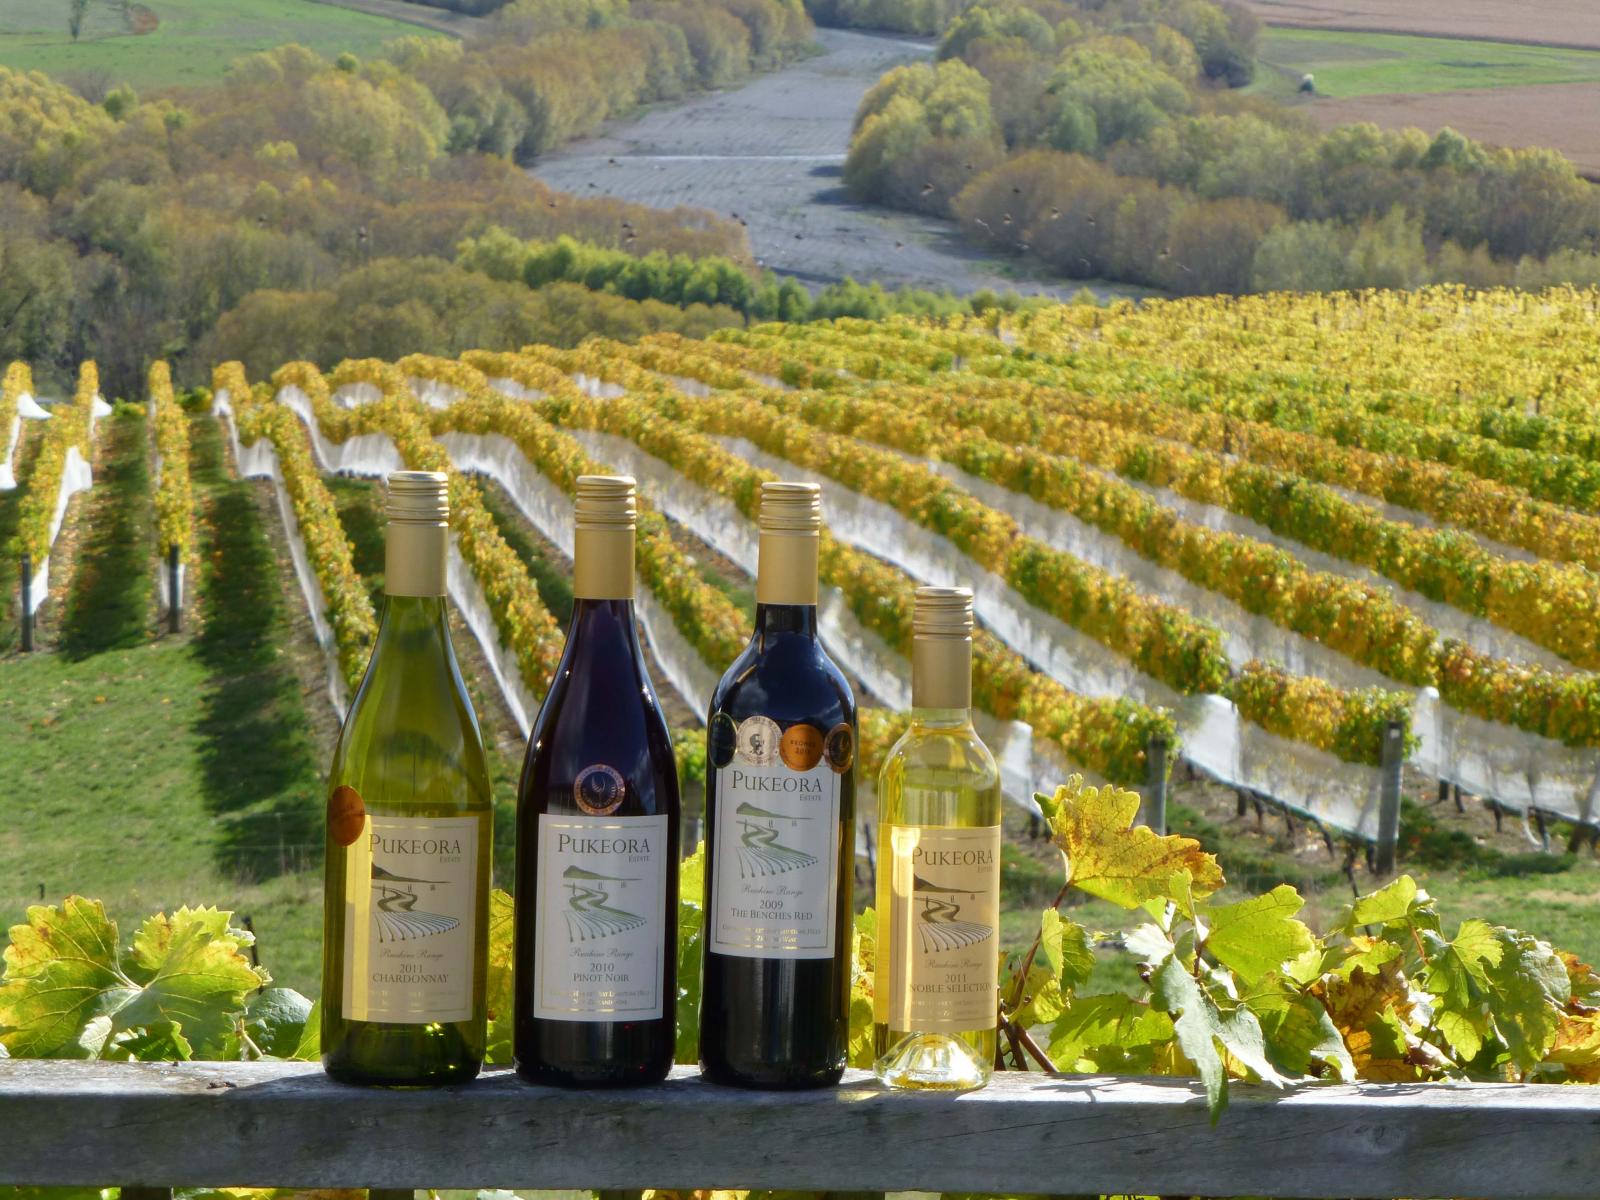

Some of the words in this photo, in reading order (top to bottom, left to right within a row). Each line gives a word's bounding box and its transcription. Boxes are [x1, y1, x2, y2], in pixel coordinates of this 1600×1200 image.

[732, 770, 822, 793] PUKEORA
[368, 833, 461, 854] PUKEORA
[558, 833, 650, 854] PUKEORA
[912, 846, 993, 866] PUKEORA
[760, 900, 783, 910] 2009
[731, 907, 748, 918] THE
[750, 909, 793, 921] BENCHES
[794, 911, 813, 921] RED
[400, 964, 422, 974] 2011
[590, 962, 615, 973] 2010
[372, 973, 449, 984] CHARDONNAY
[573, 973, 603, 982] PINOT
[605, 974, 630, 982] NOIR
[945, 973, 967, 983] 2011
[910, 983, 945, 993] NOBLE
